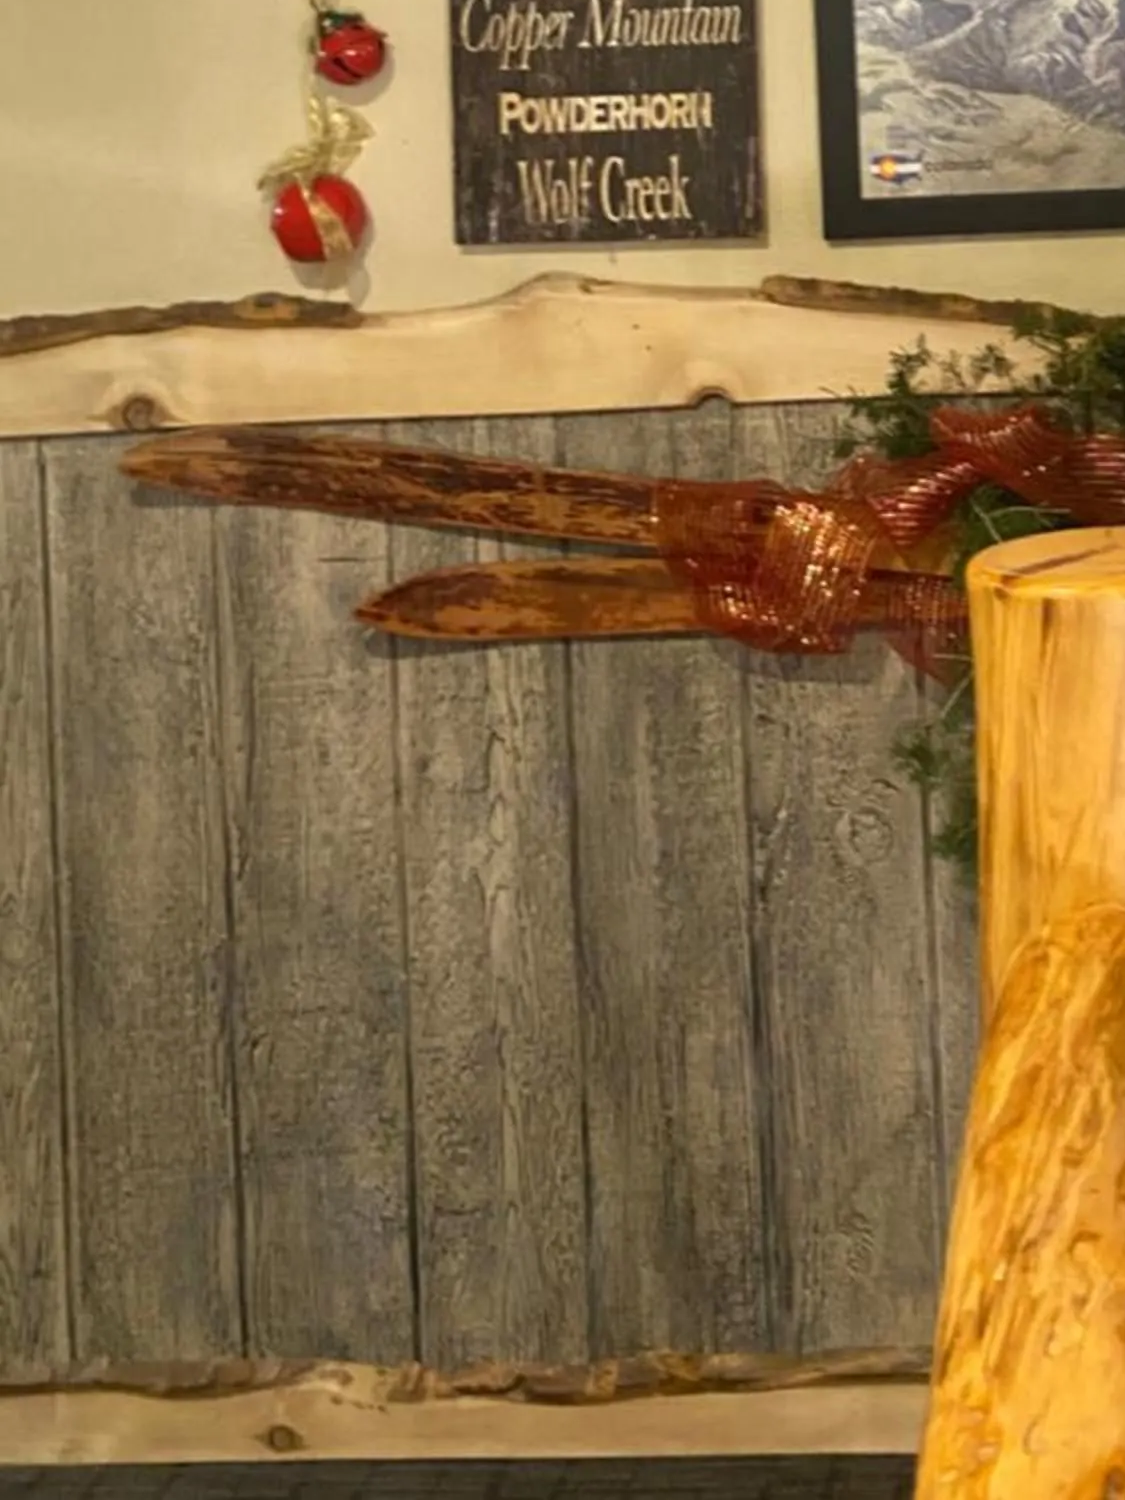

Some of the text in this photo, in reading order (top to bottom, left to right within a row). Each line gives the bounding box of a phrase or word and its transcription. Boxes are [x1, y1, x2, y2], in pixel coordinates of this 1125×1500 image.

[499, 91, 713, 135] POWDERHORN
[516, 155, 692, 224] Wolf Creek
